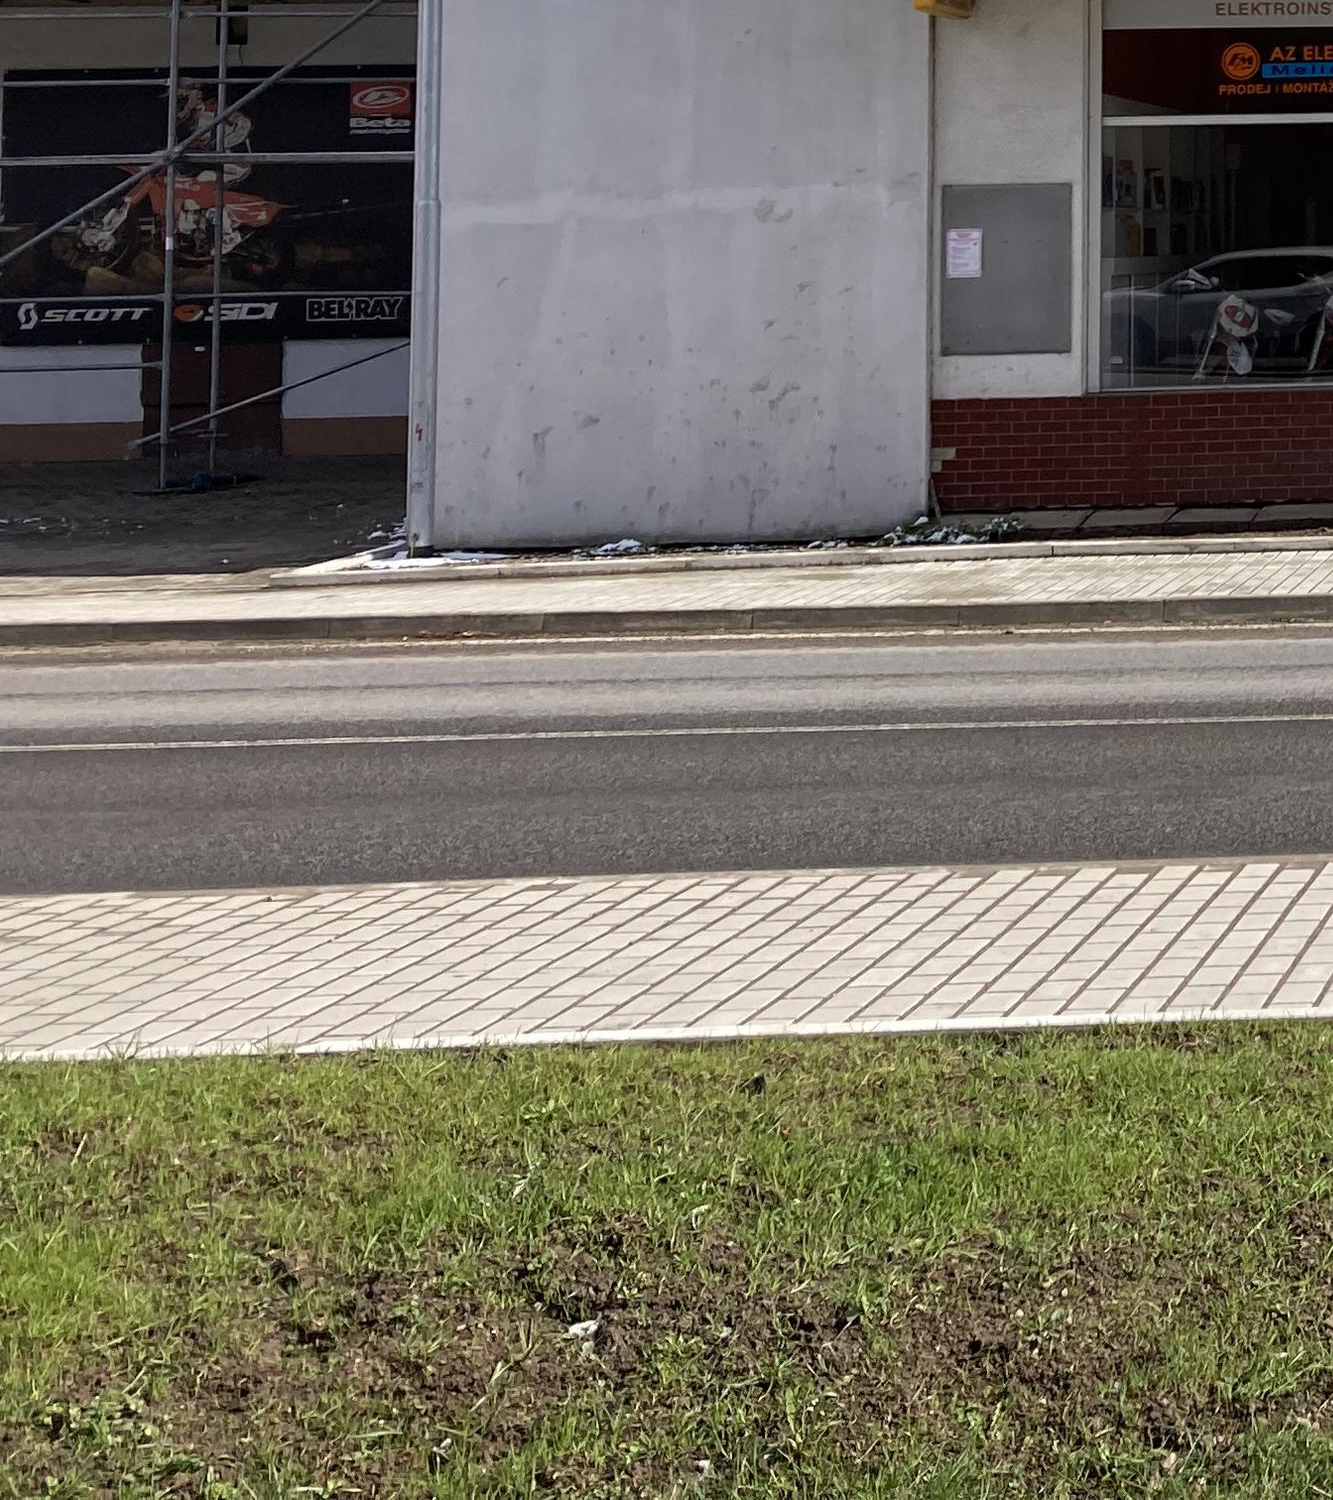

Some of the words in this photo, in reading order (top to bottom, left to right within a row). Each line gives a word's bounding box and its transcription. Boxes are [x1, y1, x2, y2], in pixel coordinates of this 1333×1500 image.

[1269, 45, 1297, 61] AZ
[1218, 83, 1272, 95] PRODEJ
[40, 307, 152, 323] SCOTT
